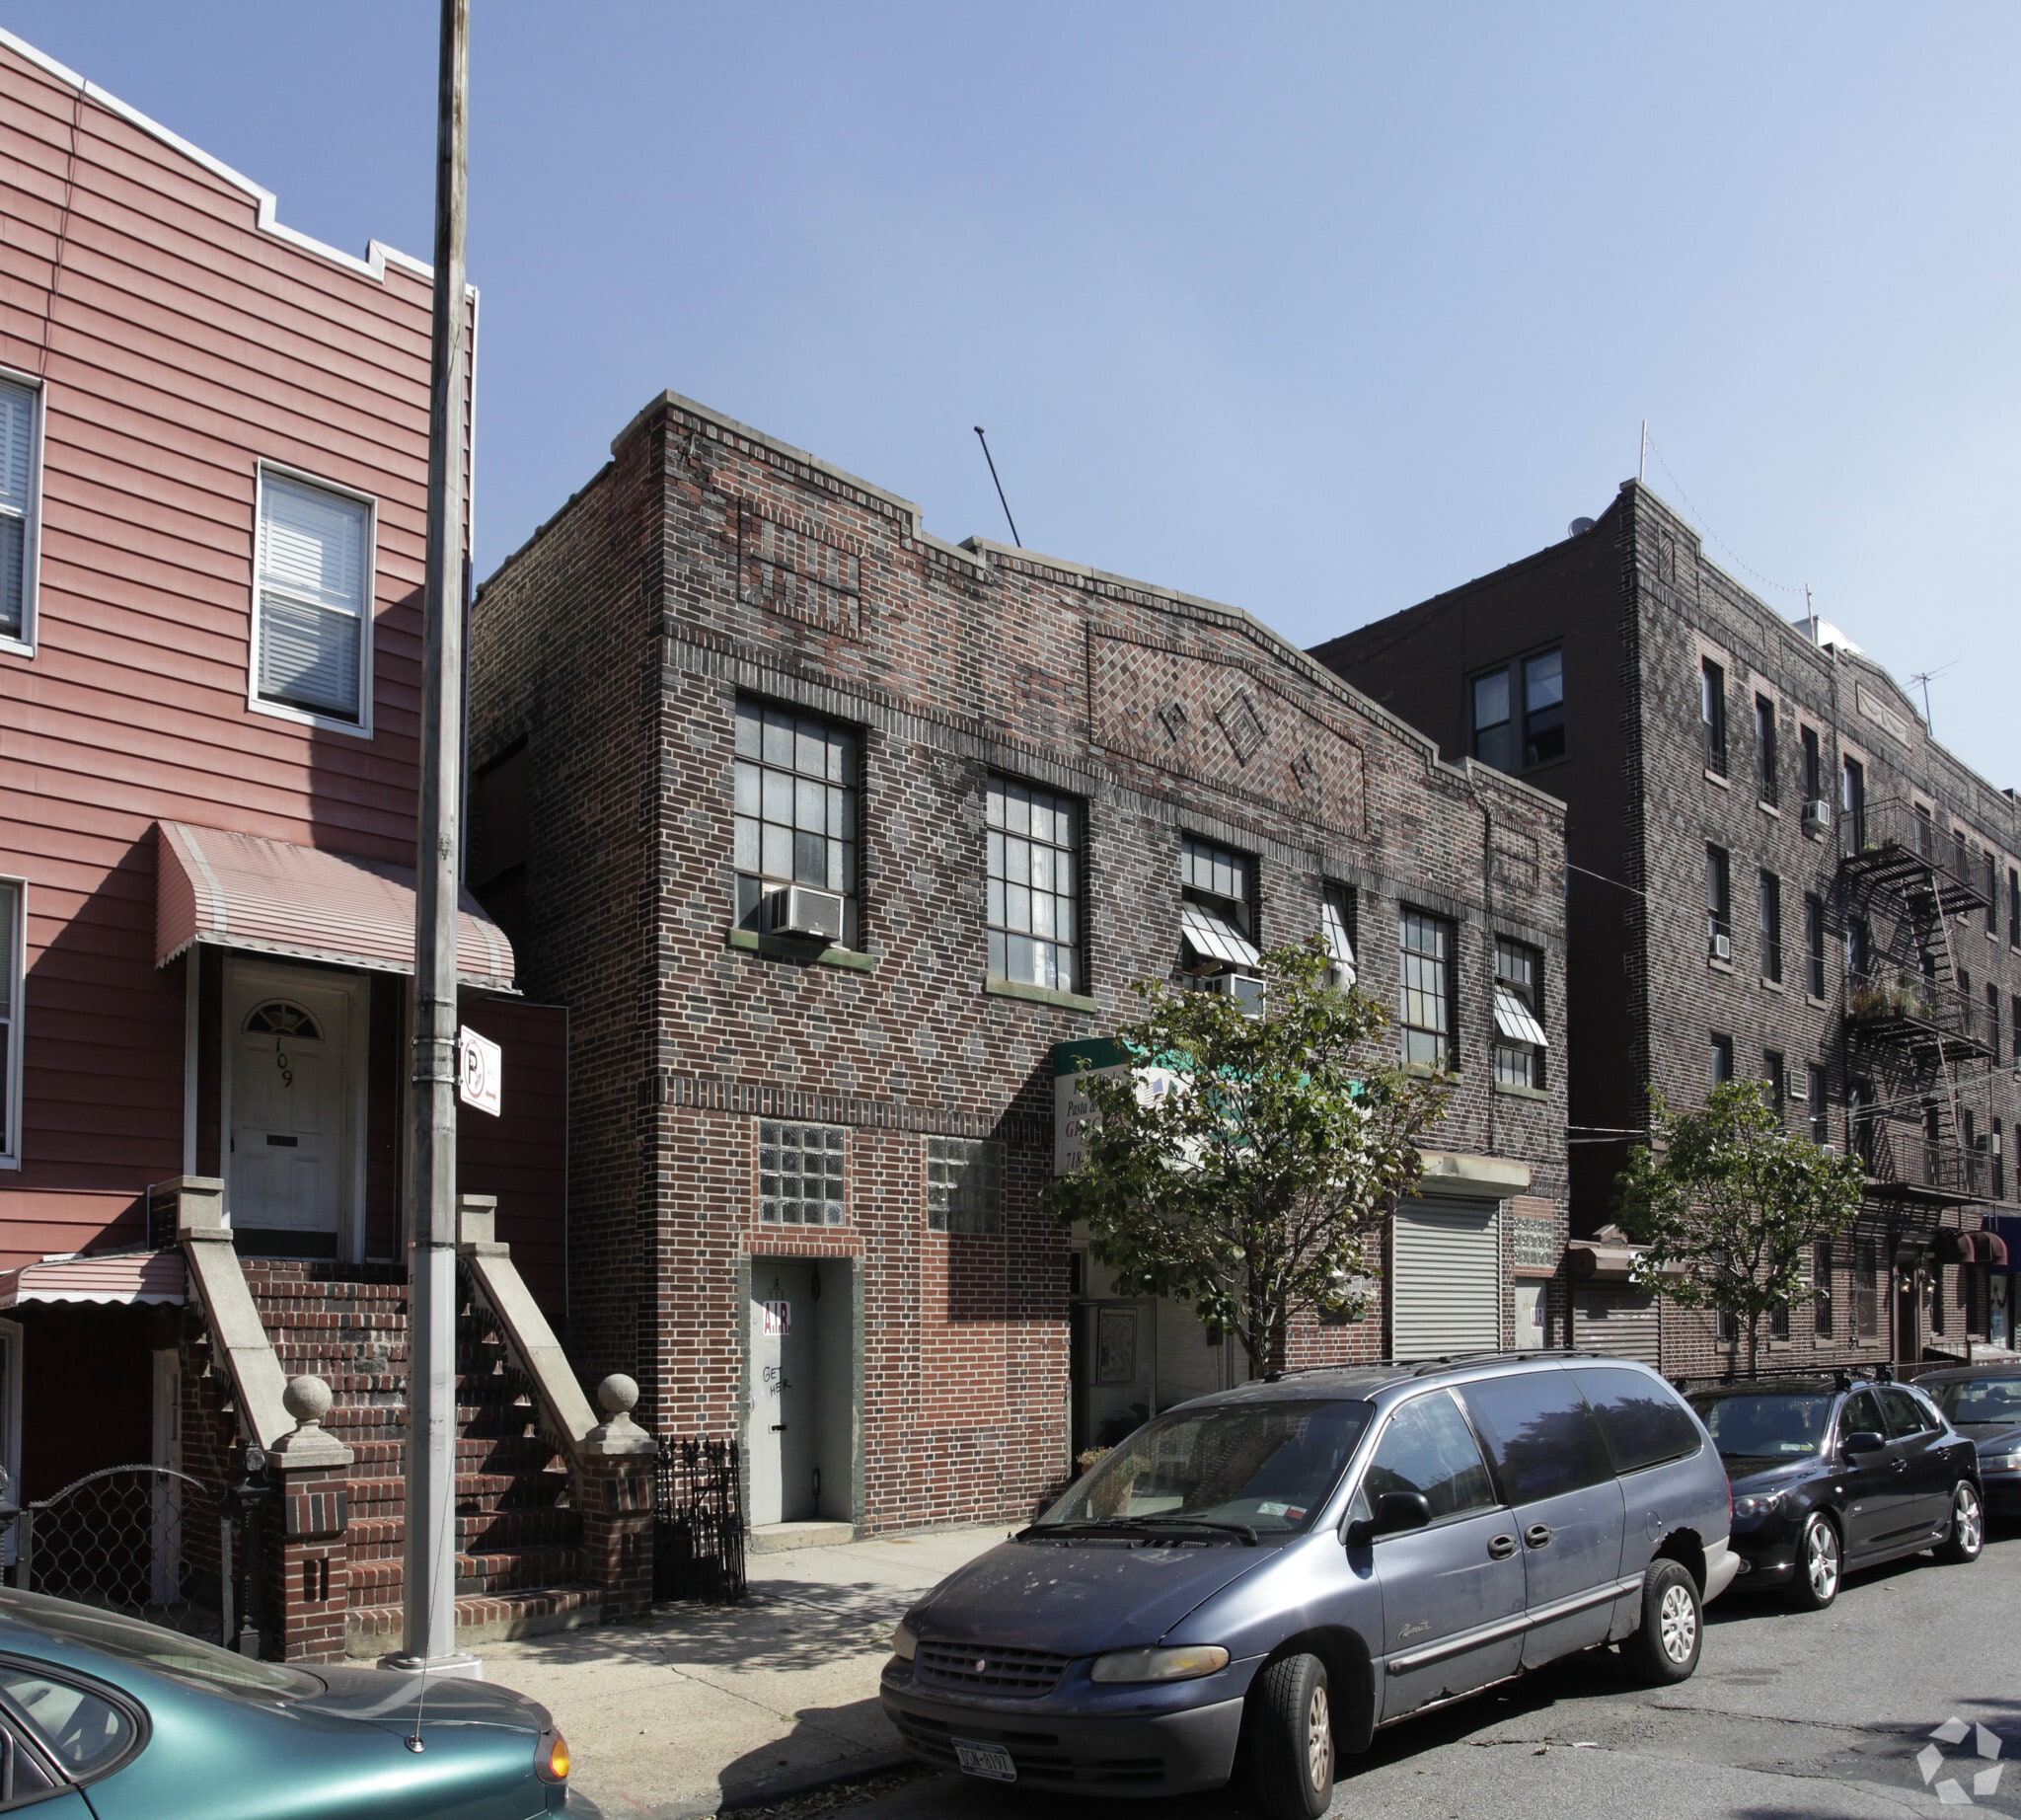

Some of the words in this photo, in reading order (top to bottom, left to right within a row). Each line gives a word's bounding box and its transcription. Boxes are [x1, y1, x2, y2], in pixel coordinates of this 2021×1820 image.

[276, 1037, 293, 1088] 109
[1067, 1100, 1087, 1117] Pasta
[763, 1366, 784, 1383] GET
[770, 1379, 792, 1397] HER
